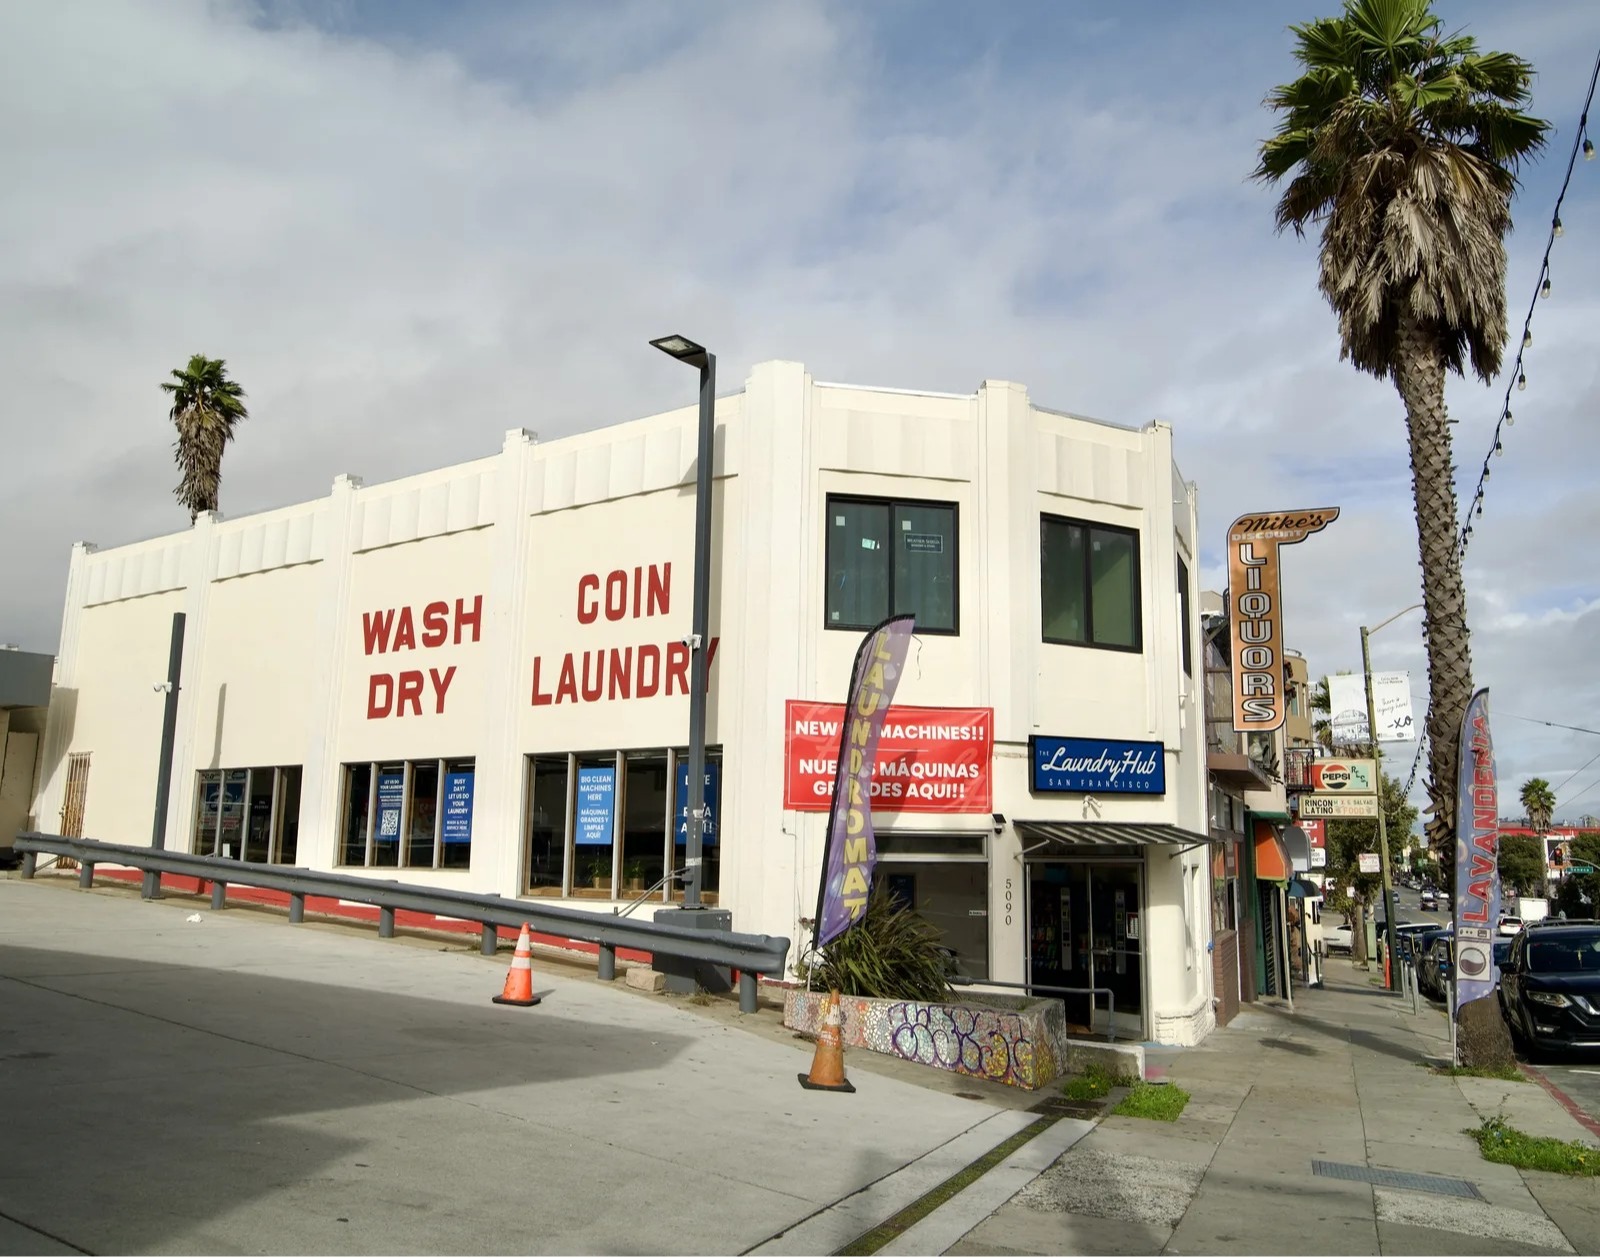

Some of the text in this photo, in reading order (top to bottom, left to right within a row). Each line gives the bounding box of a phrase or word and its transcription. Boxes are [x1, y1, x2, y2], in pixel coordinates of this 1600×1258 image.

[1238, 514, 1324, 533] Mike's
[1232, 529, 1304, 541] DISCOUNT
[577, 561, 672, 625] COIN
[362, 594, 483, 656] WASH
[1238, 542, 1277, 723] LIQUORS
[366, 665, 458, 720] DRY
[795, 720, 837, 736] NEW
[876, 724, 985, 741] MACHINES!!
[879, 757, 980, 779] MÁQUINAS
[1041, 746, 1157, 782] Laundry Hub
[592, 775, 612, 783] CLEAN
[841, 631, 892, 920] LAUNDROMAT
[1049, 778, 1150, 789] SAN FRANCISCO
[1322, 773, 1351, 781] PEPSI
[580, 784, 612, 792] MACHINES
[587, 793, 602, 801] HERE
[905, 783, 965, 800] AQUI!!
[1304, 799, 1333, 807] RINCON
[1305, 806, 1334, 815] LATINO
[1343, 806, 1364, 815] FOOD
[1462, 715, 1498, 923] LAVANDERIA
